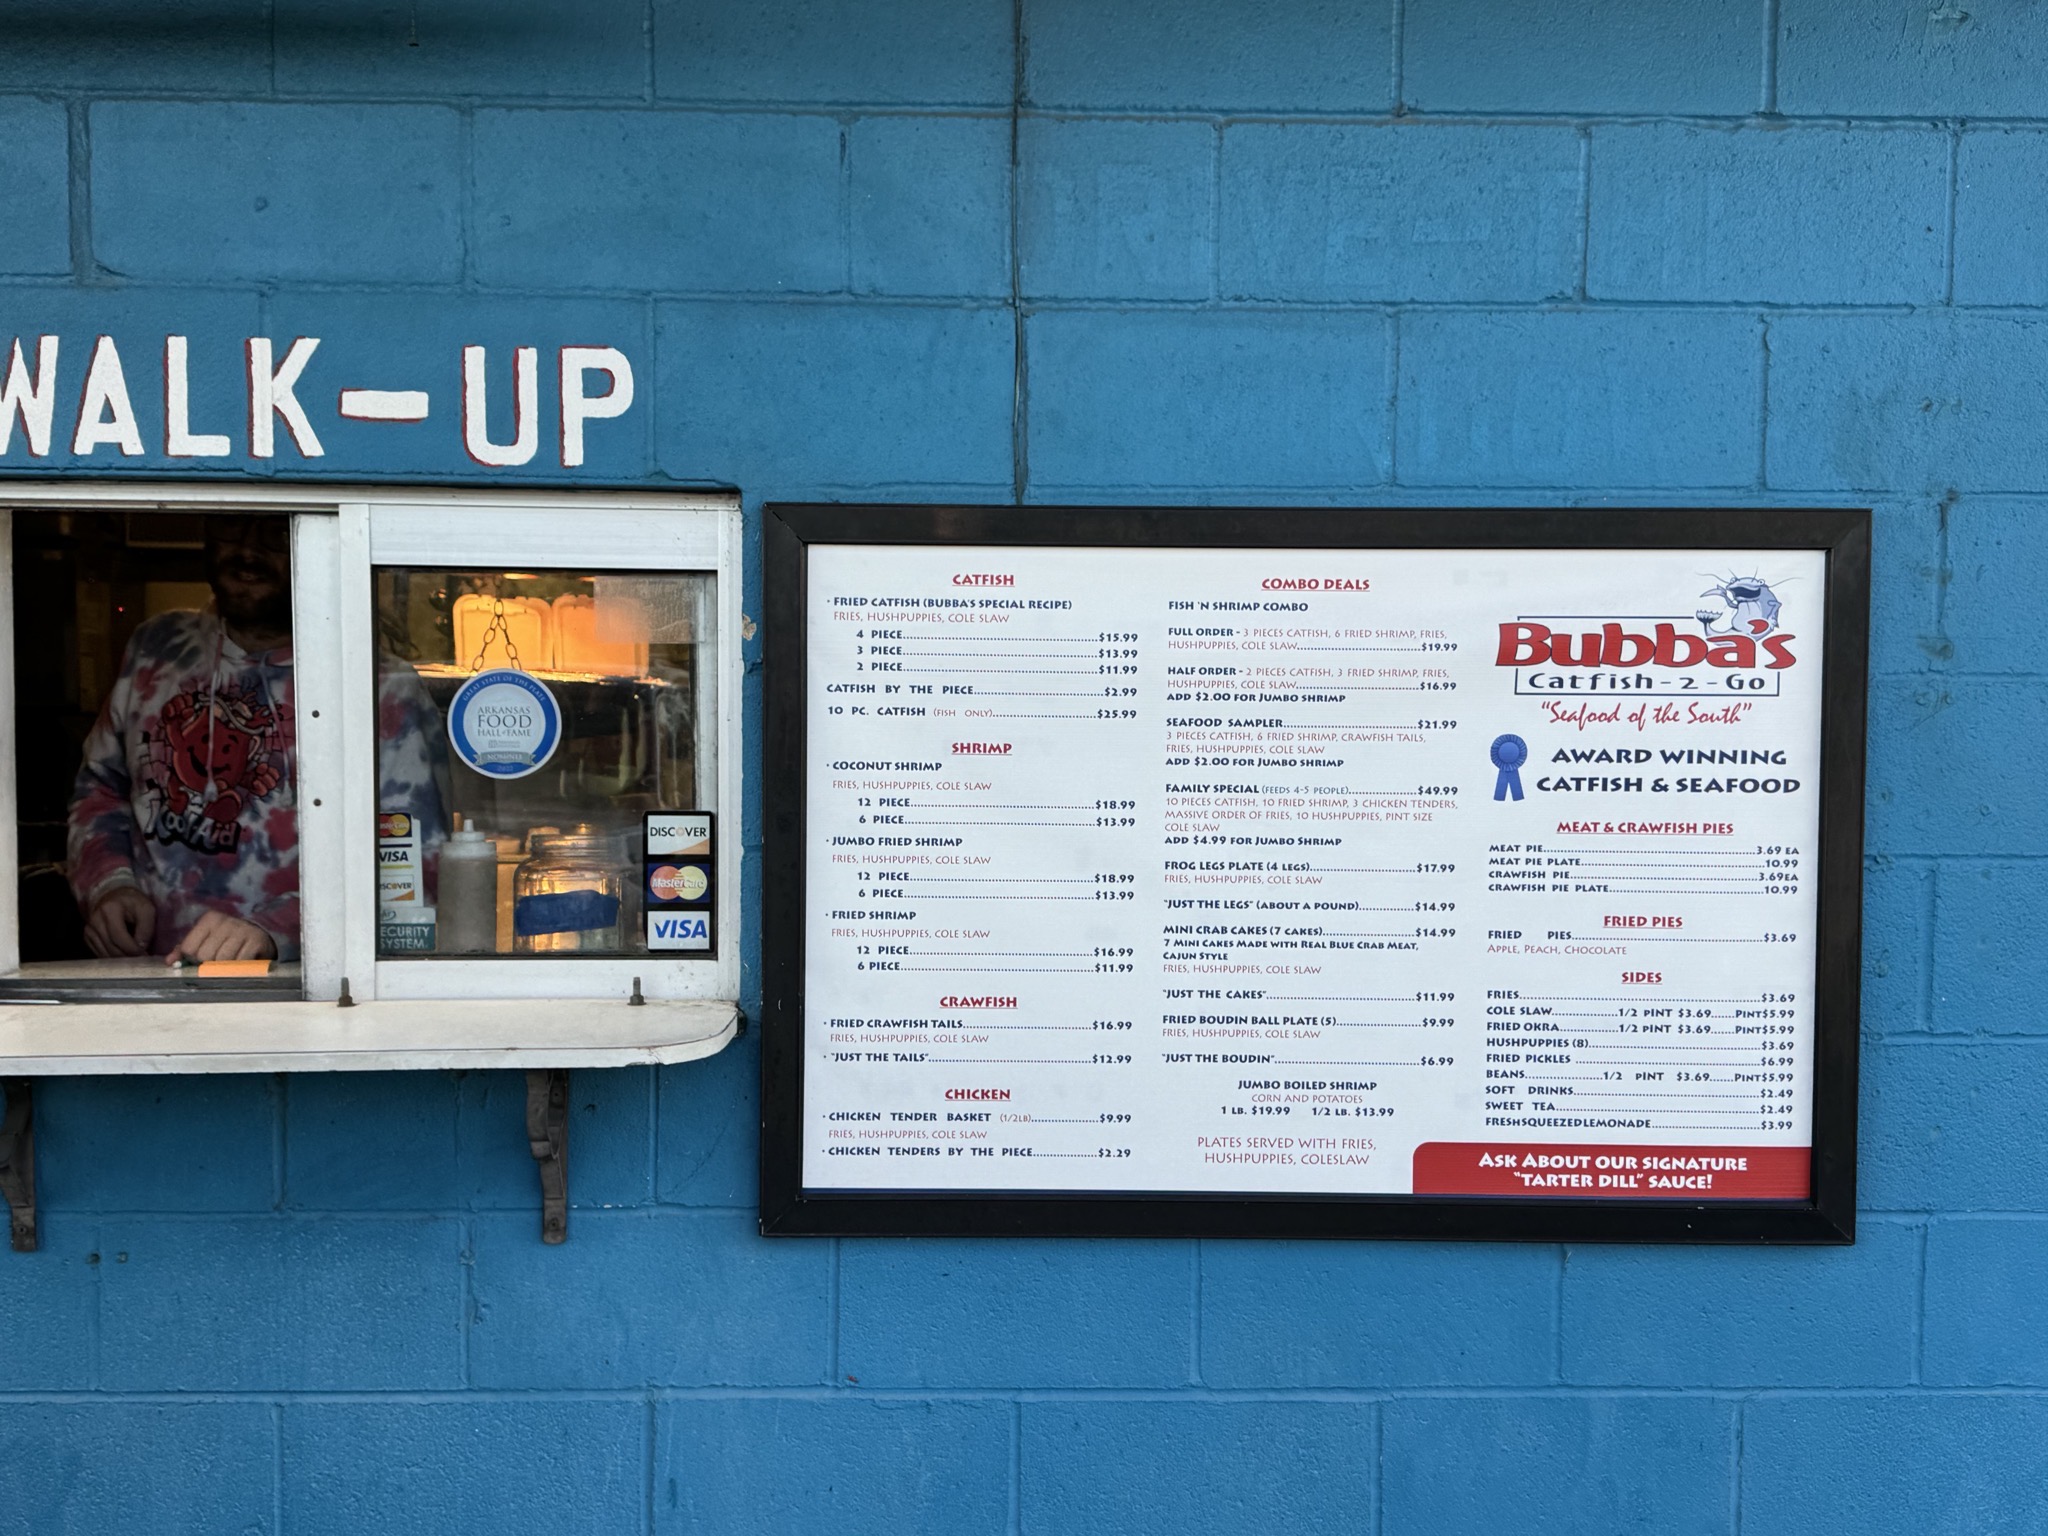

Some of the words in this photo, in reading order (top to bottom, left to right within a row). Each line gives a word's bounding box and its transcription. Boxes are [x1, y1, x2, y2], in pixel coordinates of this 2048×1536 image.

[952, 574, 1015, 585] CATFISH
[1261, 578, 1320, 590] COMBO
[1324, 579, 1370, 591] DEALS
[834, 597, 869, 607] FRIED
[871, 597, 920, 608] CATFISH
[923, 597, 976, 609] (BUBBA'S
[978, 598, 1025, 610] SPECIAL
[1028, 599, 1073, 610] RECIPE)
[1168, 601, 1194, 611] FISH
[1197, 601, 1210, 611] 'N
[1212, 601, 1260, 612] SHRIMP
[1263, 602, 1309, 612] COMBO
[833, 611, 863, 623] FRIES,
[867, 612, 945, 624] HUSHPUPPIES,
[948, 613, 975, 623] COLE
[979, 613, 1010, 624] SLAW
[856, 629, 864, 639] 4
[871, 629, 903, 639] PIECE
[1098, 632, 1138, 643] $15.99
[1495, 618, 1797, 669] Bubba's
[856, 645, 864, 655] 3
[871, 646, 903, 656] PIECE
[1098, 648, 1138, 659] $13.99
[462, 683, 480, 701] GREAT
[482, 676, 501, 686] STATE
[514, 676, 528, 688] THE
[826, 683, 876, 694] CATFISH
[885, 684, 901, 694] BY
[909, 684, 933, 695] THE
[942, 685, 974, 695] PIECE
[1104, 687, 1137, 698] $2.99
[1167, 692, 1191, 702] ADD
[1195, 692, 1231, 702] $2.00
[1234, 693, 1256, 702] FOR
[1258, 693, 1299, 703] JUMBO
[1301, 694, 1346, 703] SHRIMP
[477, 706, 531, 714] ARKANSAS
[828, 706, 844, 716] 10
[851, 706, 869, 717] PC.
[877, 706, 926, 717] CATFISH
[933, 707, 956, 718] (FISH
[964, 708, 993, 718] ONLY)
[1097, 709, 1137, 720] $25.99
[1627, 701, 1647, 732] of
[1653, 703, 1681, 723] the
[478, 714, 532, 728] FOOD
[1166, 717, 1222, 728] SEAFOOD
[1228, 718, 1283, 728] SAMPLER
[1417, 719, 1457, 730] $21.99
[477, 729, 501, 737] HALL
[506, 729, 531, 737] FAME
[952, 742, 1012, 754] SHRIMP
[1551, 747, 1652, 764] AWARD
[1659, 749, 1787, 765] WINNING
[832, 761, 892, 771] COCONUT
[894, 761, 943, 772] SHRIMP
[1165, 783, 1211, 794] FAMILY
[1213, 784, 1260, 794] SPECIAL
[1261, 785, 1290, 795] (FEEDS
[1293, 785, 1310, 795] 4-5
[1313, 785, 1349, 796] PEOPLE)
[1417, 786, 1458, 797] $49.99
[1536, 776, 1643, 792] CATFISH
[1650, 778, 1670, 792] &
[1676, 777, 1801, 794] SEAFOOD
[650, 826, 708, 837] DISCOVER
[1556, 821, 1601, 833] MEAT
[1603, 822, 1615, 833] &
[1617, 821, 1698, 834] CRAWFISH
[1702, 822, 1734, 835] PIES
[831, 836, 875, 847] JUMBO
[878, 836, 912, 847] FRIED
[915, 837, 963, 847] SHRIMP
[379, 851, 409, 862] VISA
[1489, 844, 1521, 853] MEAT
[1526, 844, 1544, 853] PIE
[1756, 846, 1782, 855] 3.69
[1785, 847, 1800, 856] EA
[1164, 861, 1196, 871] FROG
[1199, 861, 1226, 871] LEGS
[1228, 861, 1264, 872] PLATE
[1266, 861, 1279, 873] (4
[1281, 862, 1311, 873] LEGS)
[1416, 862, 1456, 873] $17.99
[651, 878, 705, 889] MasterCard
[857, 872, 871, 881] 12
[878, 872, 910, 882] PIECE
[1094, 873, 1135, 884] $18.99
[1488, 883, 1546, 893] CRAWFISH
[1551, 884, 1569, 893] PIE
[1575, 884, 1609, 893] PLATE
[1764, 885, 1798, 895] 10.99
[1603, 915, 1648, 928] FRIED
[1652, 916, 1683, 928] PIES
[380, 926, 430, 937] ECURITY
[654, 919, 708, 938] VISA
[1163, 925, 1193, 935] MINI
[1195, 925, 1228, 935] CRAB
[1230, 925, 1268, 935] CAKES
[1269, 925, 1281, 937] (7
[1284, 926, 1323, 937] CAKES)
[1415, 927, 1456, 938] $14.99
[1621, 971, 1663, 983] SIDES
[939, 996, 1018, 1008] CRAWFISH
[1487, 990, 1520, 1000] FRIES
[1761, 993, 1796, 1004] $3.69
[830, 1019, 865, 1029] FRIED
[866, 1019, 929, 1029] CRAWFISH
[931, 1019, 963, 1029] TAILS
[1092, 1021, 1132, 1031] $16.99
[1486, 1038, 1570, 1048] HUSHPUPPIES
[1572, 1038, 1589, 1049] (8)
[1761, 1040, 1795, 1051] $3.69
[1238, 1080, 1281, 1090] JUMBO
[1284, 1080, 1327, 1090] BOILED
[1329, 1081, 1377, 1091] SHRIMP
[945, 1089, 1011, 1100] CHICKEN
[1251, 1093, 1281, 1103] CORN
[1284, 1094, 1309, 1104] AND
[1312, 1094, 1363, 1104] POTATOES
[1485, 1101, 1524, 1111] SWEET
[1531, 1101, 1556, 1111] TEA
[1760, 1104, 1793, 1115] $2.49
[828, 1112, 881, 1122] CHICKEN
[890, 1112, 938, 1122] TENDER
[947, 1113, 992, 1123] BASKET
[1099, 1113, 1132, 1124] $9.99
[1197, 1136, 1242, 1149] PLATES
[1246, 1137, 1294, 1149] SERVED
[1297, 1137, 1336, 1150] WITH
[1342, 1138, 1377, 1151] FRIES,
[1204, 1152, 1297, 1166] HUSHPUPPIES,
[1301, 1153, 1370, 1166] COLESLAW
[1478, 1153, 1517, 1169] ASK
[1522, 1153, 1591, 1169] ABOUT
[1595, 1156, 1638, 1170] OUR
[1642, 1157, 1748, 1171] SIGNATURE
[1649, 1174, 1713, 1189] SAUCE!
